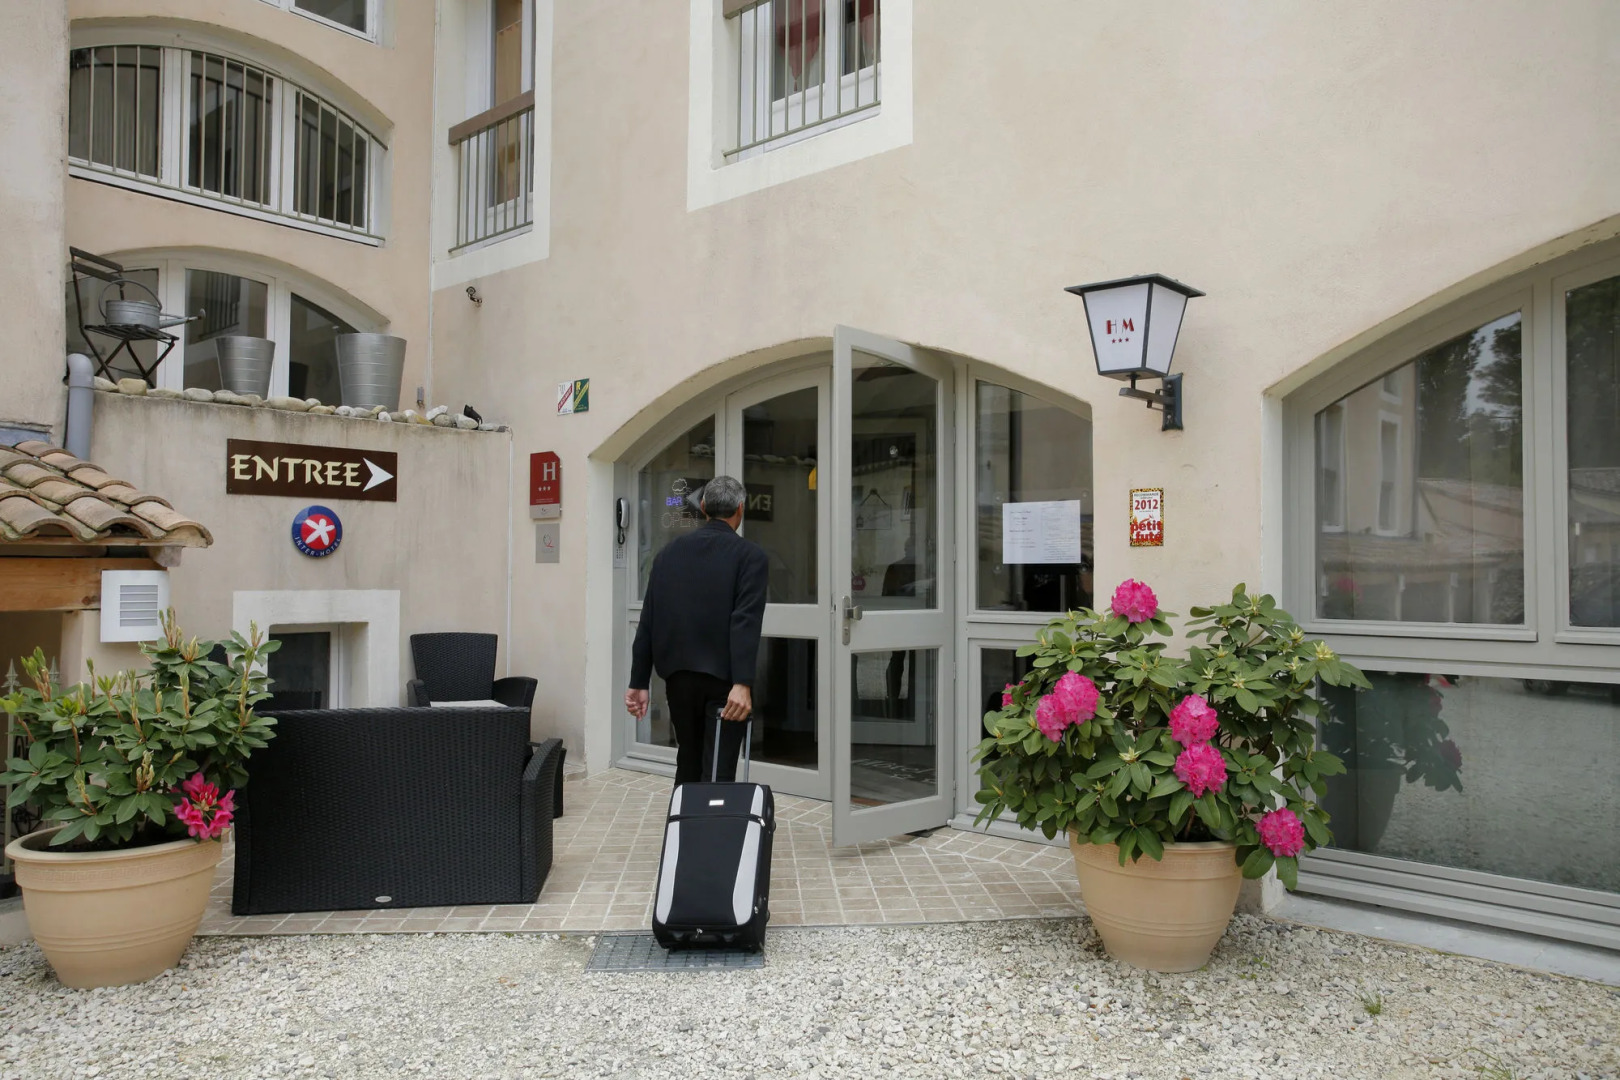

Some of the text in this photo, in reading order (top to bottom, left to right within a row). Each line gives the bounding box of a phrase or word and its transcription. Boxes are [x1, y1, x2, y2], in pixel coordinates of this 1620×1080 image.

[230, 454, 362, 487] ENTREE
[542, 461, 556, 481] H
[666, 496, 683, 506] BAR
[1134, 499, 1159, 510] 2012
[1130, 520, 1163, 534] petit
